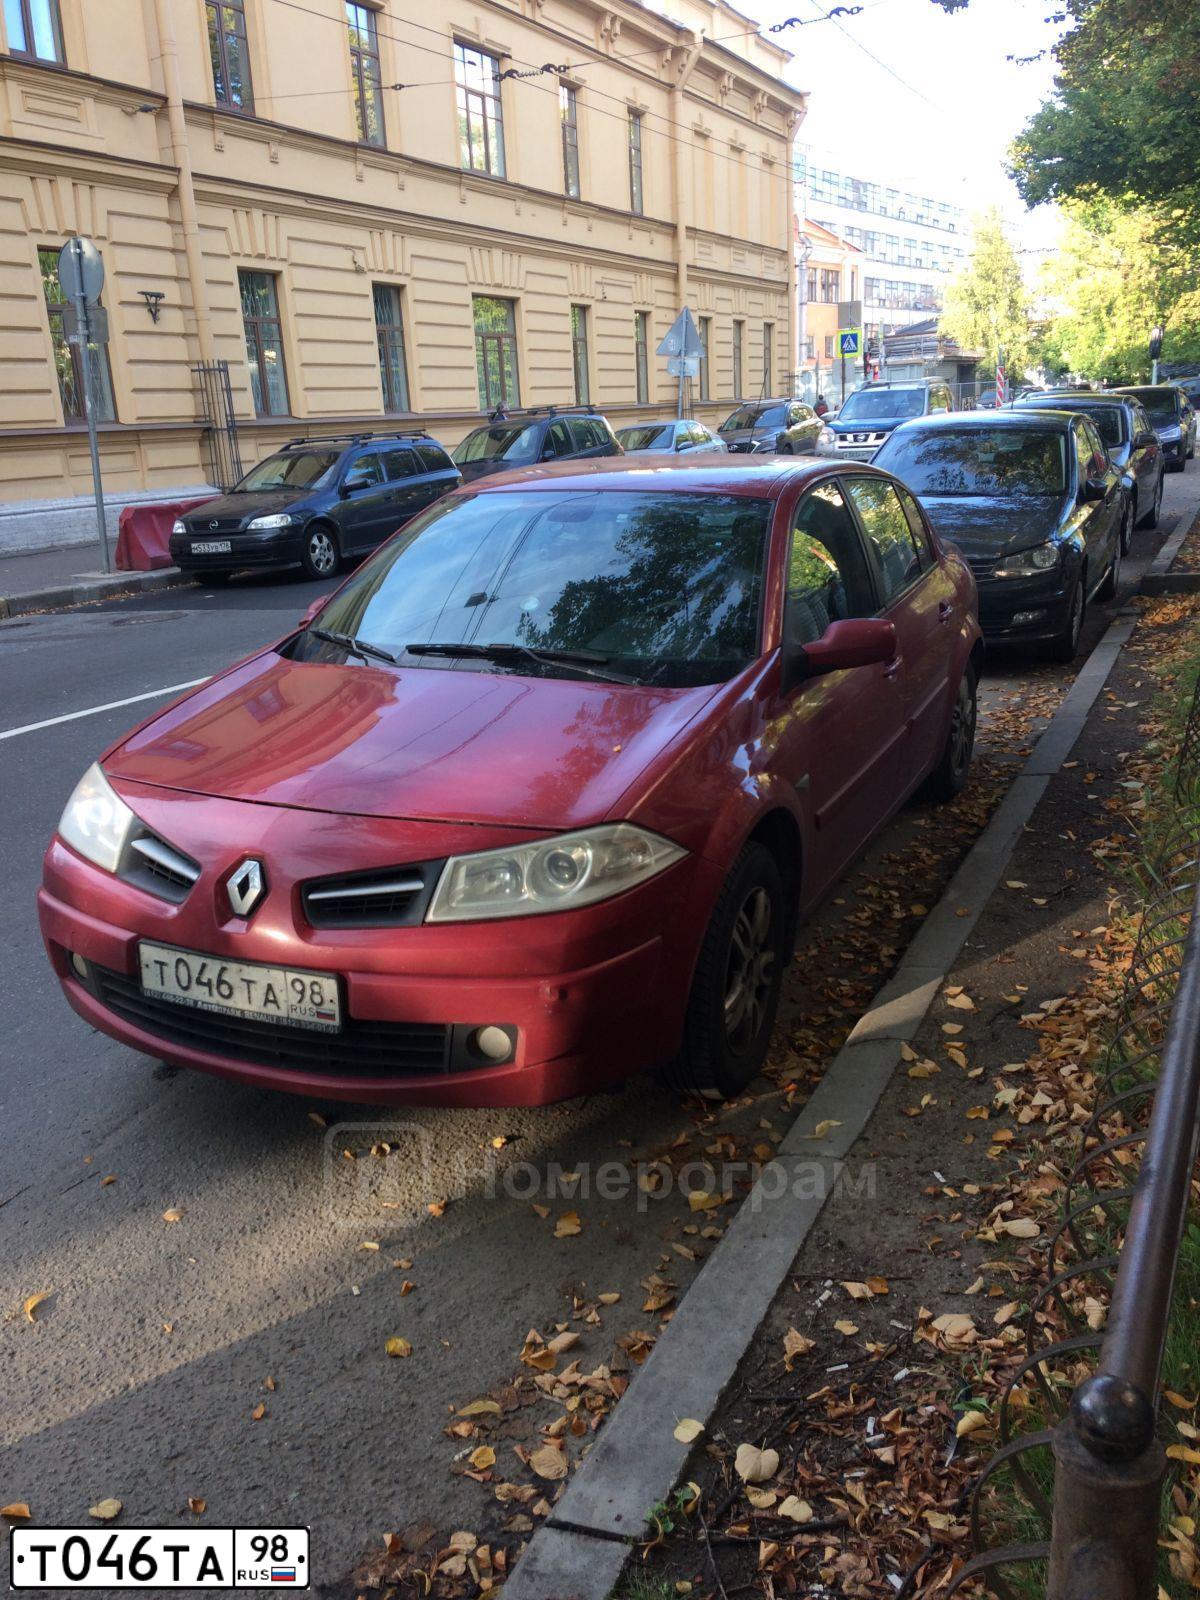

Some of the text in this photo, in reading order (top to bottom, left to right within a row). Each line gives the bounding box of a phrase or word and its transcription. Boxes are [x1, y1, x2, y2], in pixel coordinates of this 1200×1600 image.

[153, 957, 281, 1010] Т046ТА
[290, 977, 325, 1007] 98
[290, 1004, 317, 1017] RUS
